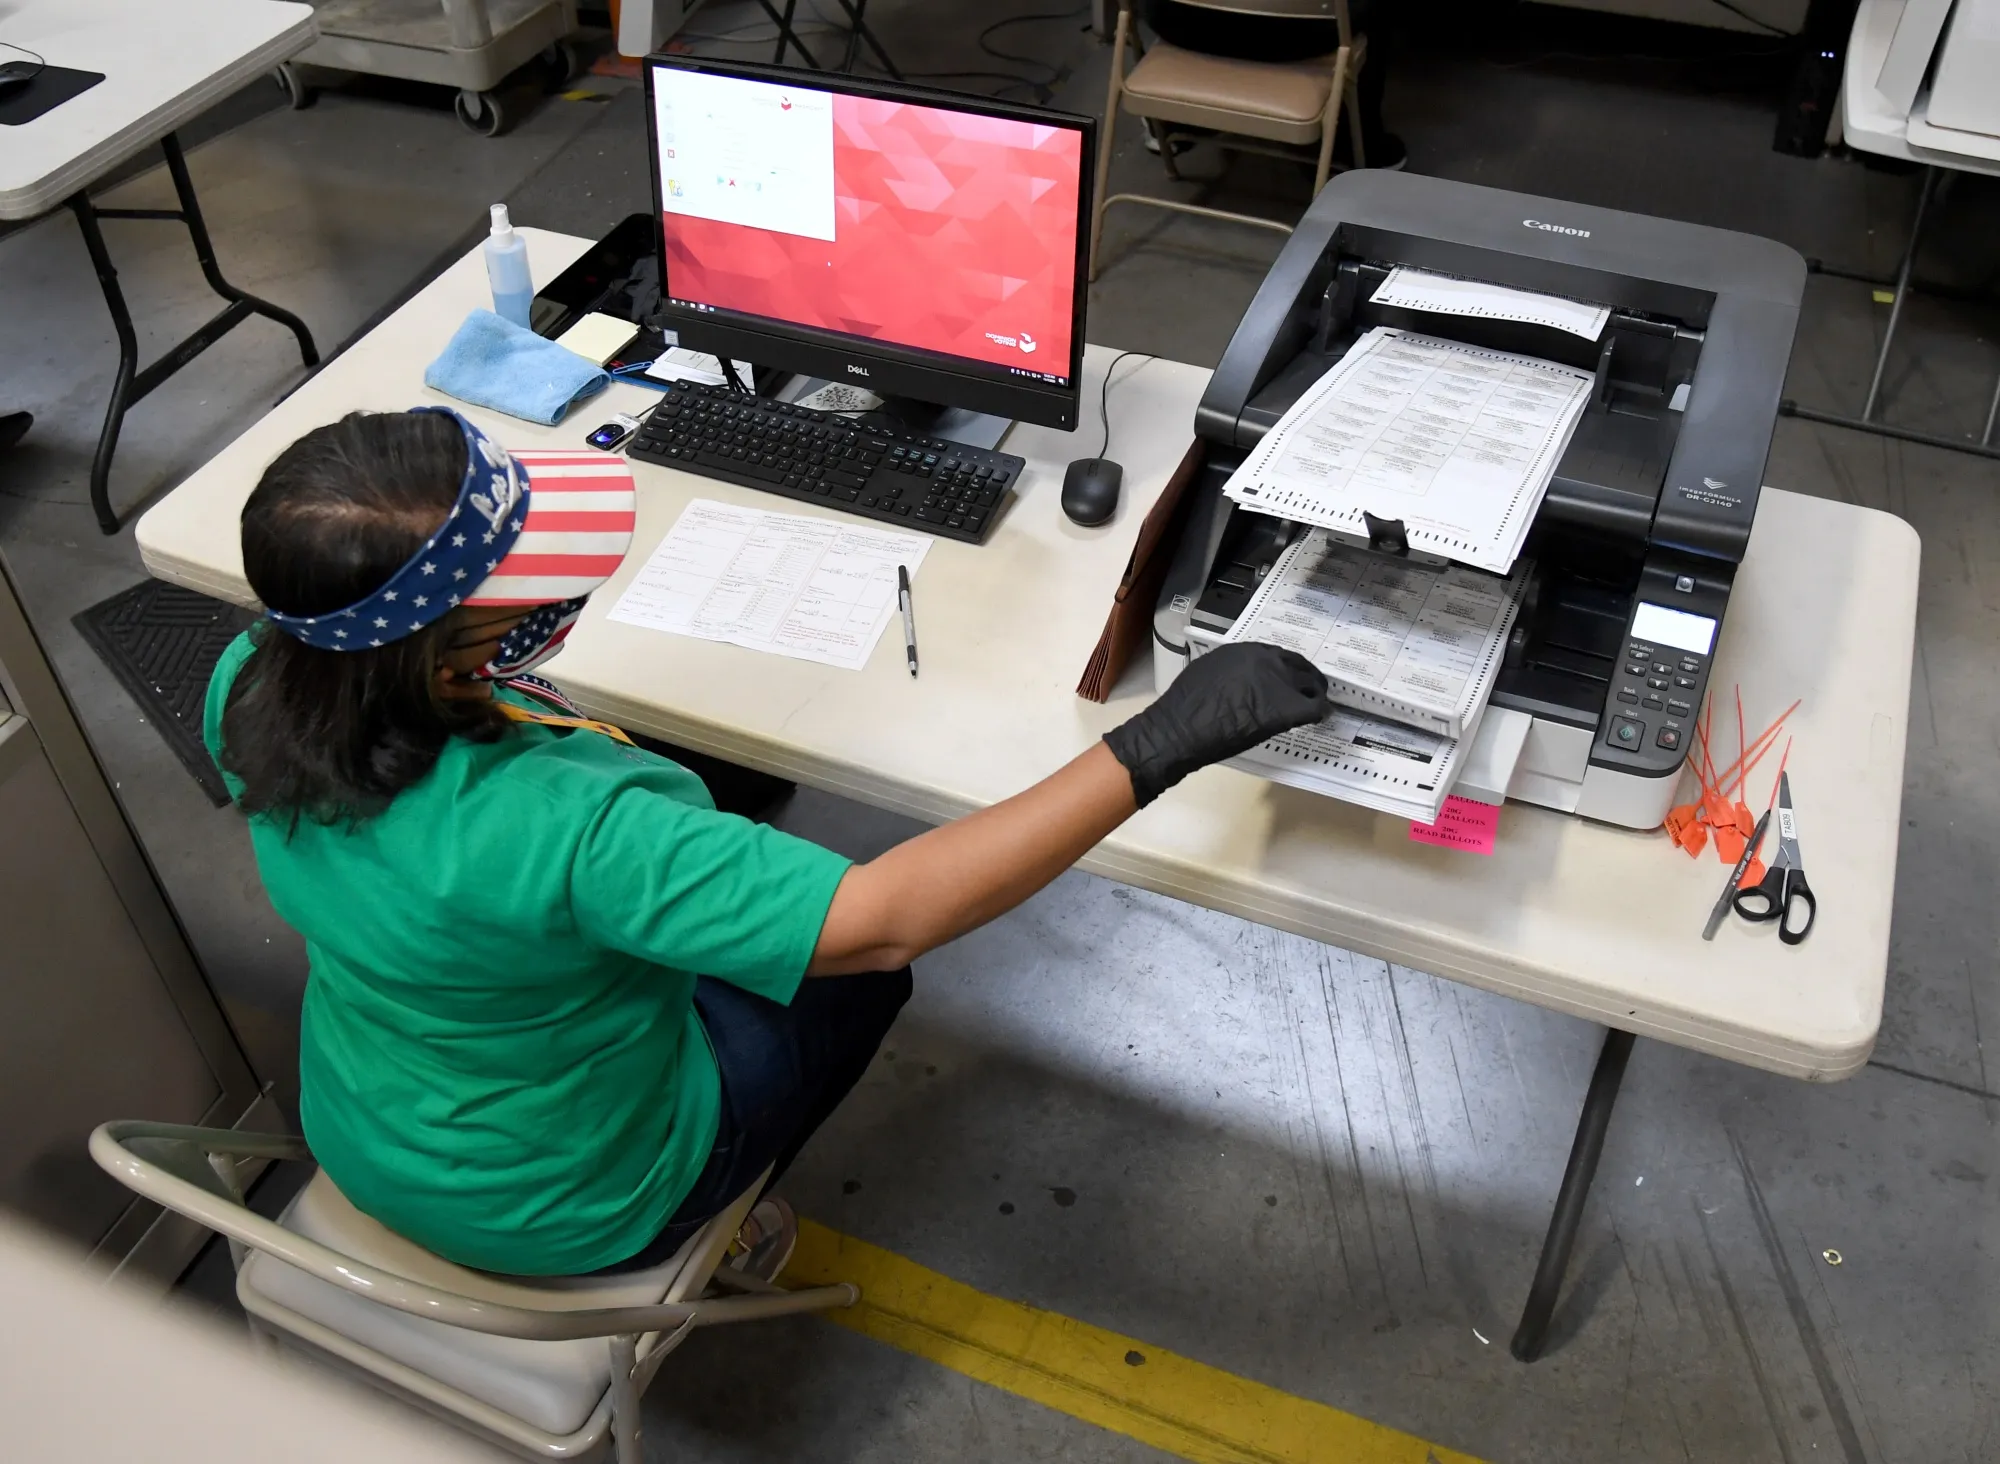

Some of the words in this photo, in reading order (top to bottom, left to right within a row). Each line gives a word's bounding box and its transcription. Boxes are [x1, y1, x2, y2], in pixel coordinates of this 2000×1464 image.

[1522, 219, 1590, 238] Canon
[985, 332, 1016, 342] DOMINION
[994, 339, 1016, 347] VOTING
[848, 364, 870, 376] DELL
[1679, 486, 1742, 503] imageFORMULA
[1686, 493, 1732, 508] DR-G2140
[1639, 644, 1654, 653] Select
[1684, 656, 1698, 664] Menu
[1669, 698, 1690, 708] Function
[1444, 814, 1486, 826] BALLOTS
[1413, 827, 1438, 837] READ
[1440, 833, 1482, 845] BALLOTS
